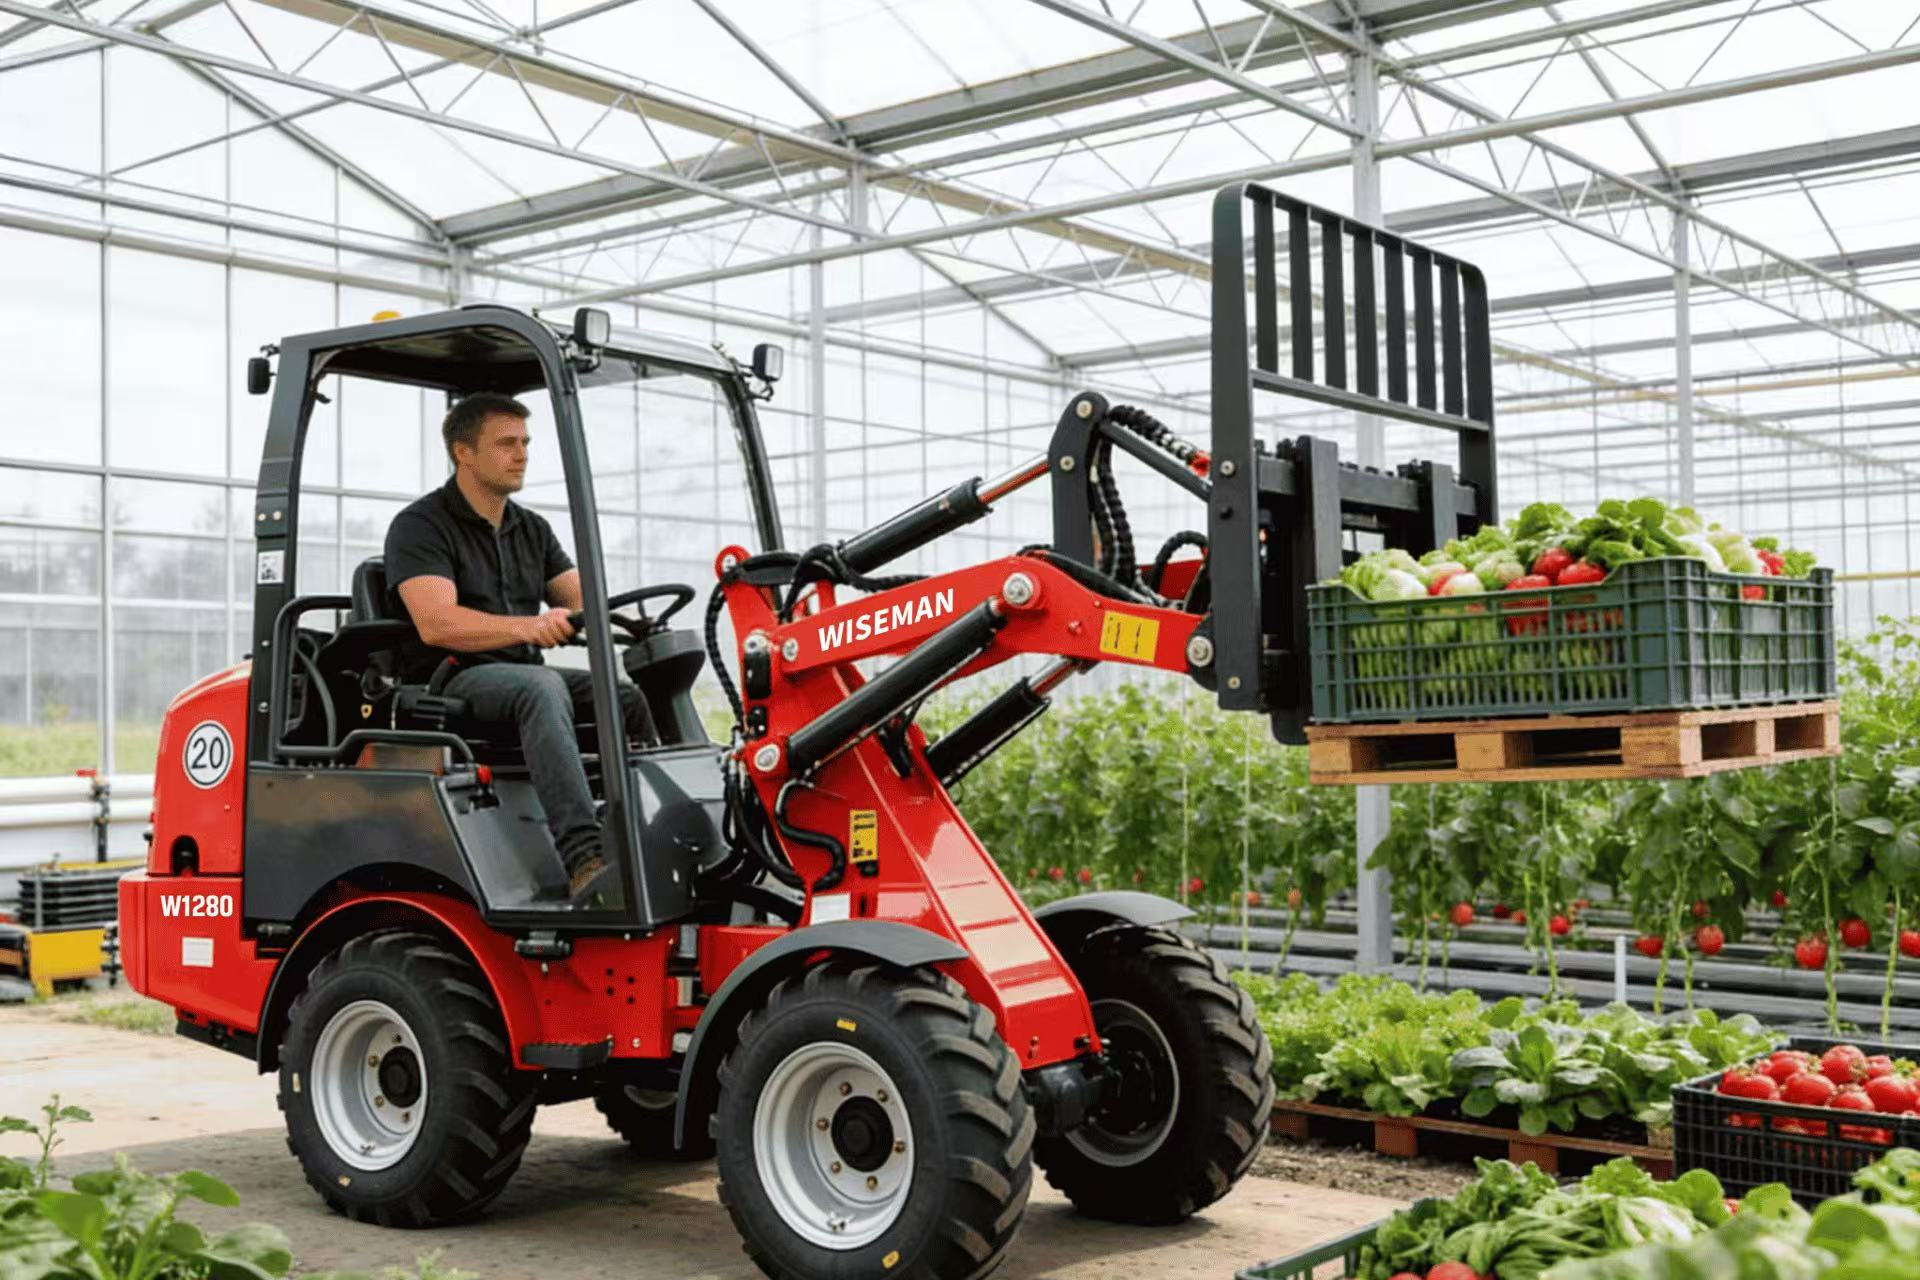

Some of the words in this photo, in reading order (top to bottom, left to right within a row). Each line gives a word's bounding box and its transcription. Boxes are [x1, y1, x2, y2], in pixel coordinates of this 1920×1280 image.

[818, 588, 954, 651] WISEMAN
[191, 736, 225, 769] 20
[160, 895, 233, 917] W1280
